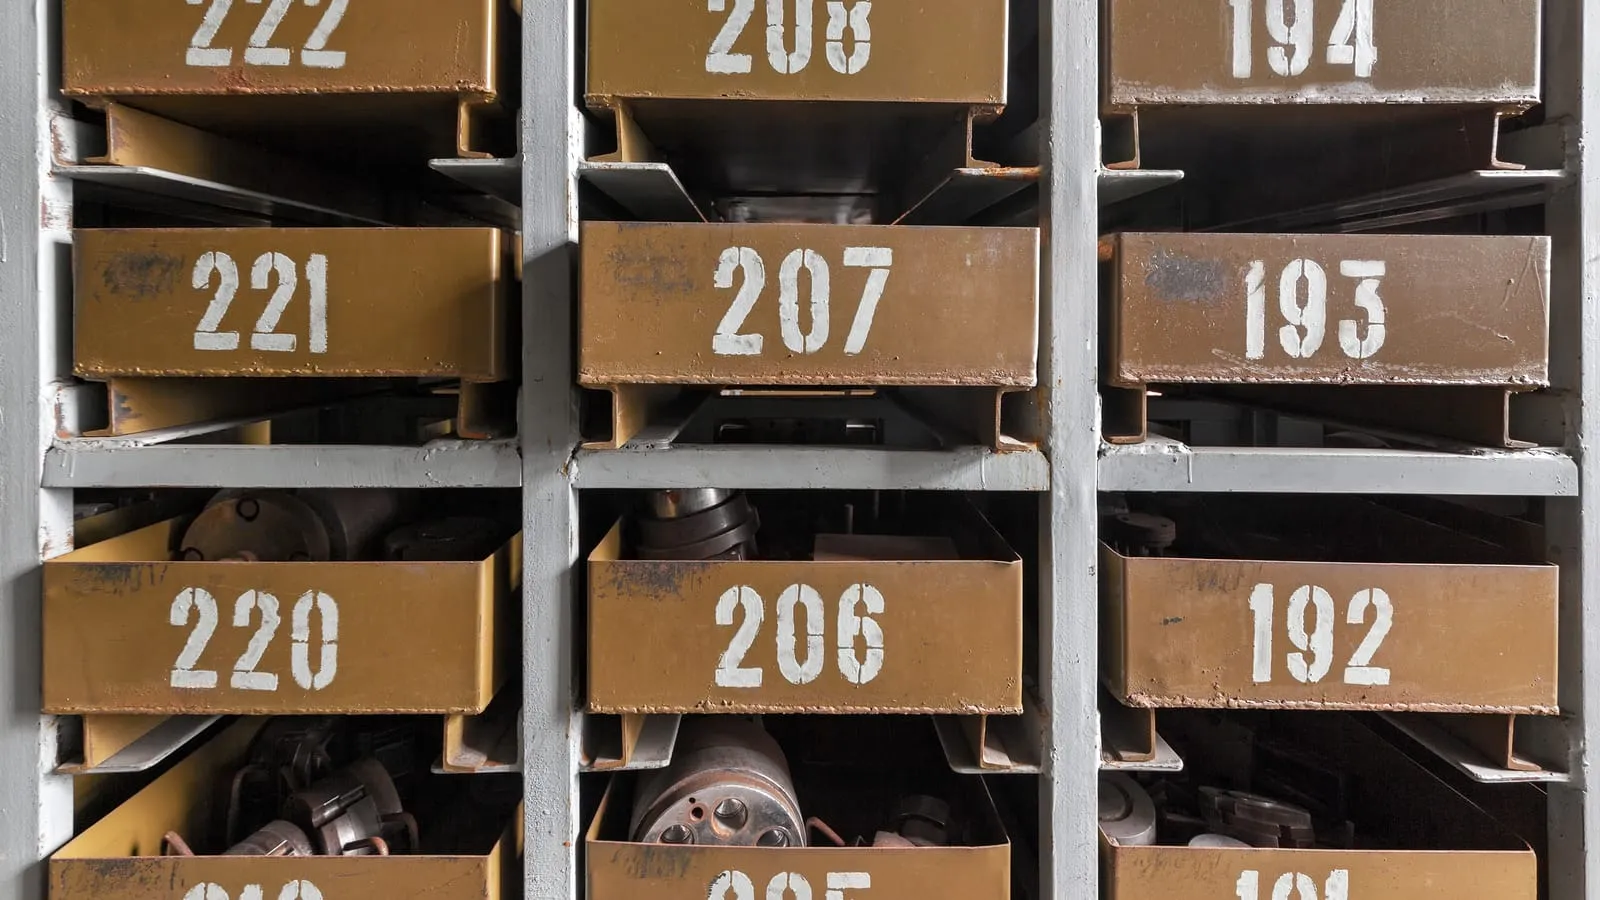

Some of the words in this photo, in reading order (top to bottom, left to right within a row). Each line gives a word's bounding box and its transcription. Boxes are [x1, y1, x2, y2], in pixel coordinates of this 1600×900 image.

[186, 0, 348, 68] 222
[706, 0, 872, 74] 208
[1230, 0, 1378, 78] 194
[192, 251, 328, 353] 221
[712, 246, 893, 356] 207
[1245, 258, 1387, 360] 193
[170, 587, 339, 691] 220
[715, 583, 885, 688] 206
[1248, 583, 1394, 686] 192
